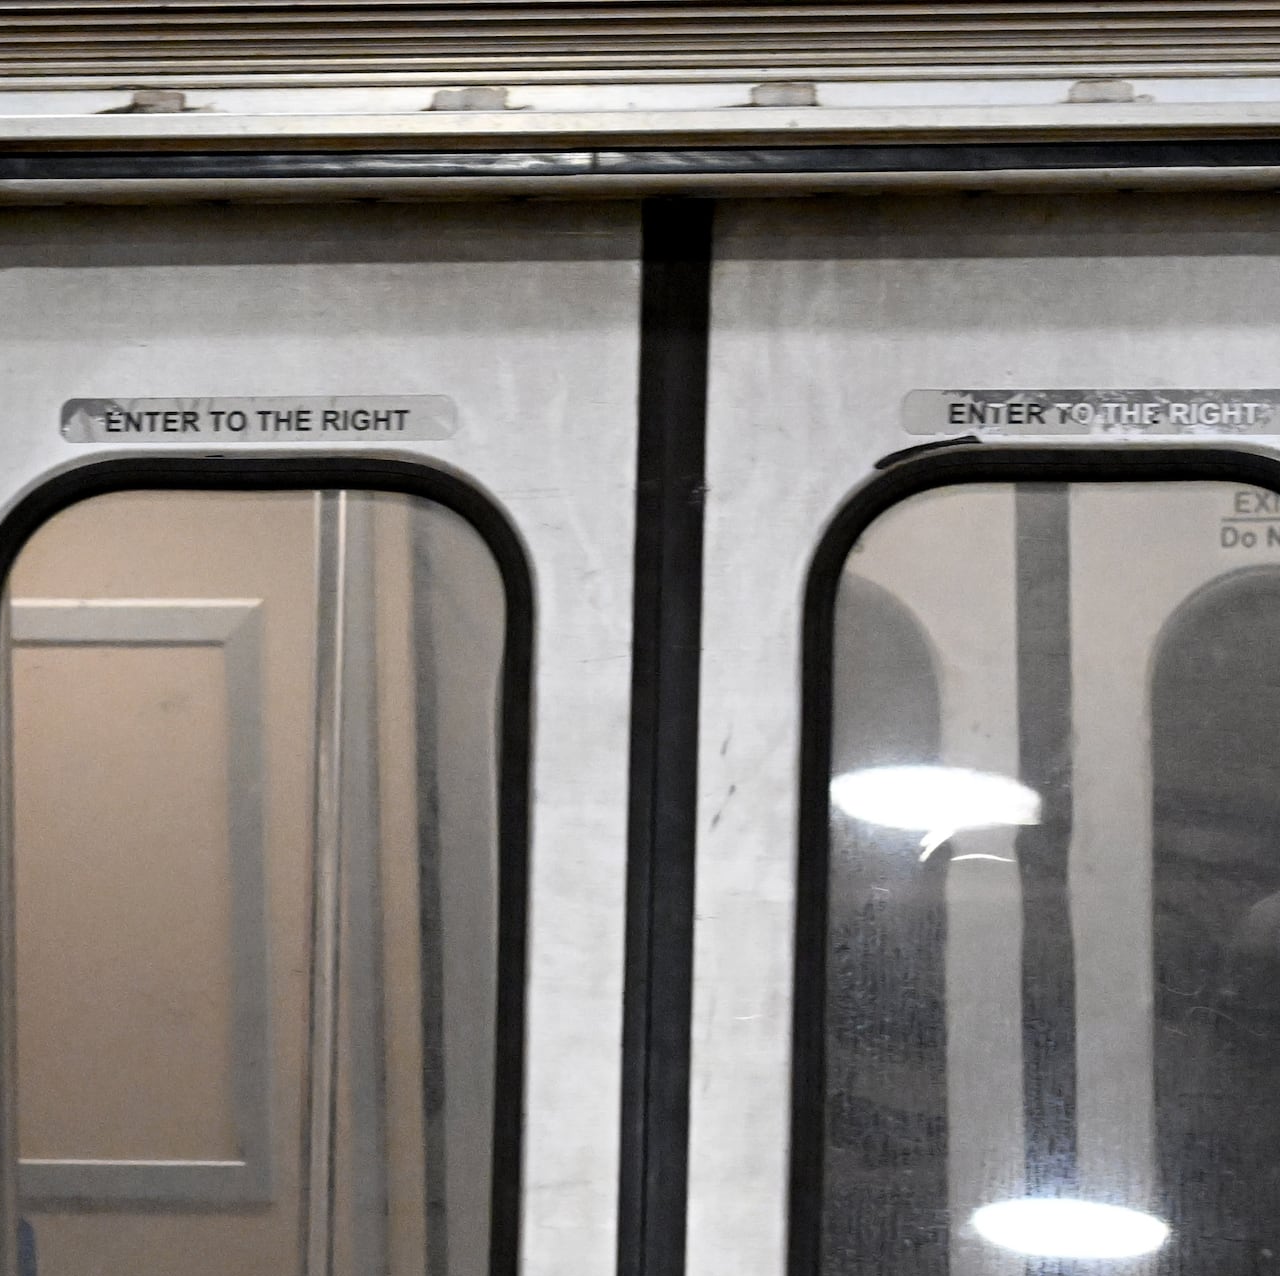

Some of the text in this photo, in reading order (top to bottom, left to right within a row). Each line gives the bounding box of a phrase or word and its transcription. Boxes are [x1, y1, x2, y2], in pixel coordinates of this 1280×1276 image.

[104, 409, 411, 433] ENTER TO THE RIGHT
[948, 402, 1260, 425] ENTER TO THE RIGHT
[1221, 526, 1257, 548] Do
